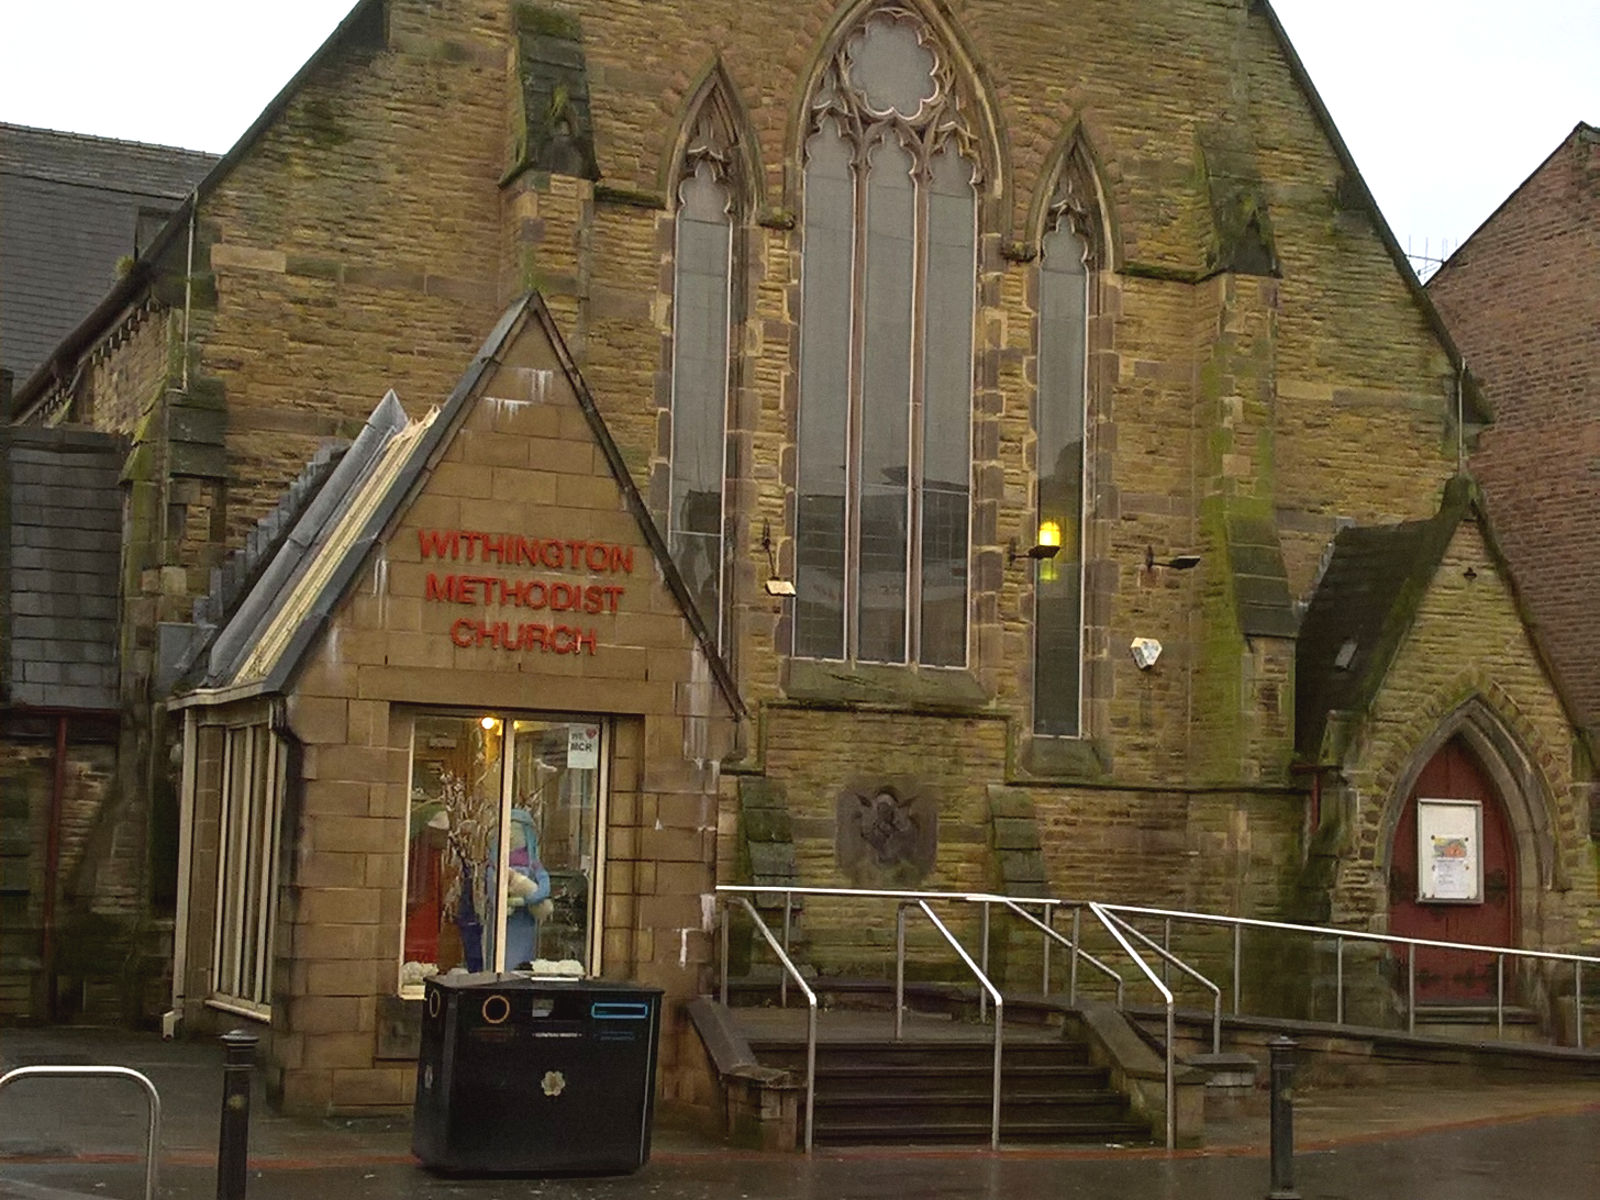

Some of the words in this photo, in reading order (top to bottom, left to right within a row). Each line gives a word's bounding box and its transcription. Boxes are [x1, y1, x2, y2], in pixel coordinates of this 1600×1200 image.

[418, 529, 634, 574] WITHINGTON
[426, 572, 625, 614] METHODIST
[450, 617, 597, 656] CHURCH
